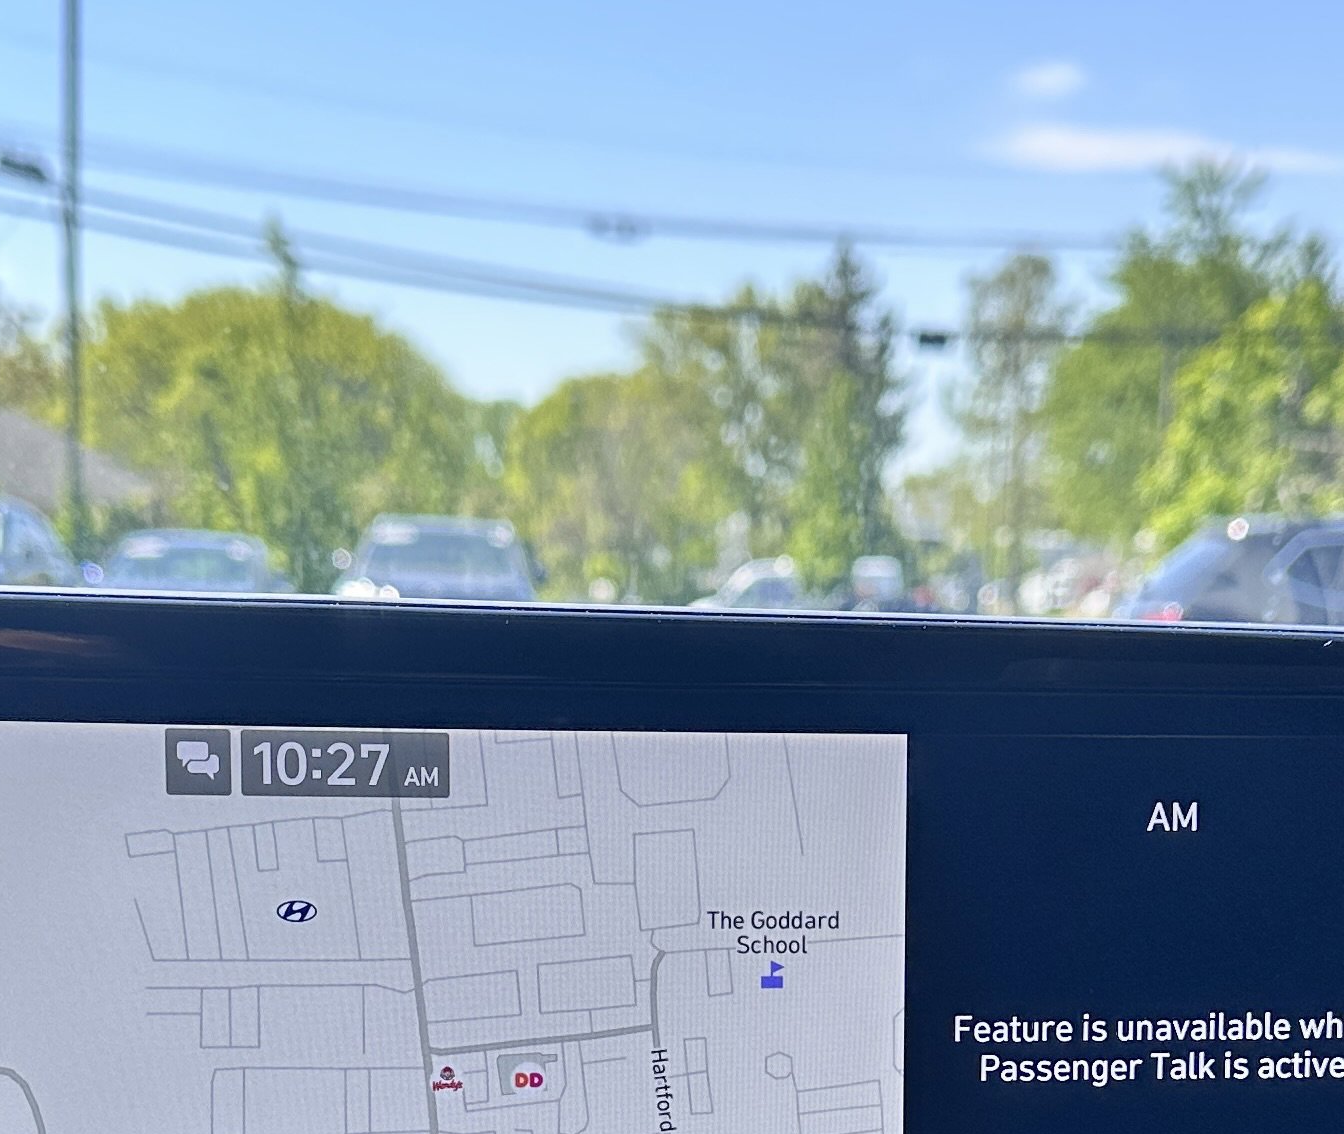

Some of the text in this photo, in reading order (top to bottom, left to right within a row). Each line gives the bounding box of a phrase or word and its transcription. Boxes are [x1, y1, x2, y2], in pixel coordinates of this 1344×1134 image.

[253, 741, 439, 787] 10:27 AM
[1146, 801, 1198, 832] AM
[706, 910, 840, 930] The Goddard
[736, 934, 808, 955] School
[954, 1015, 1074, 1043] Feature
[1082, 1013, 1108, 1042] is
[1115, 1011, 1292, 1042] unavailable
[514, 1071, 544, 1089] DD
[980, 1054, 1141, 1088] Passenger
[1150, 1051, 1216, 1081] Talk
[1224, 1050, 1250, 1080] is
[651, 1048, 678, 1133] Hartford
